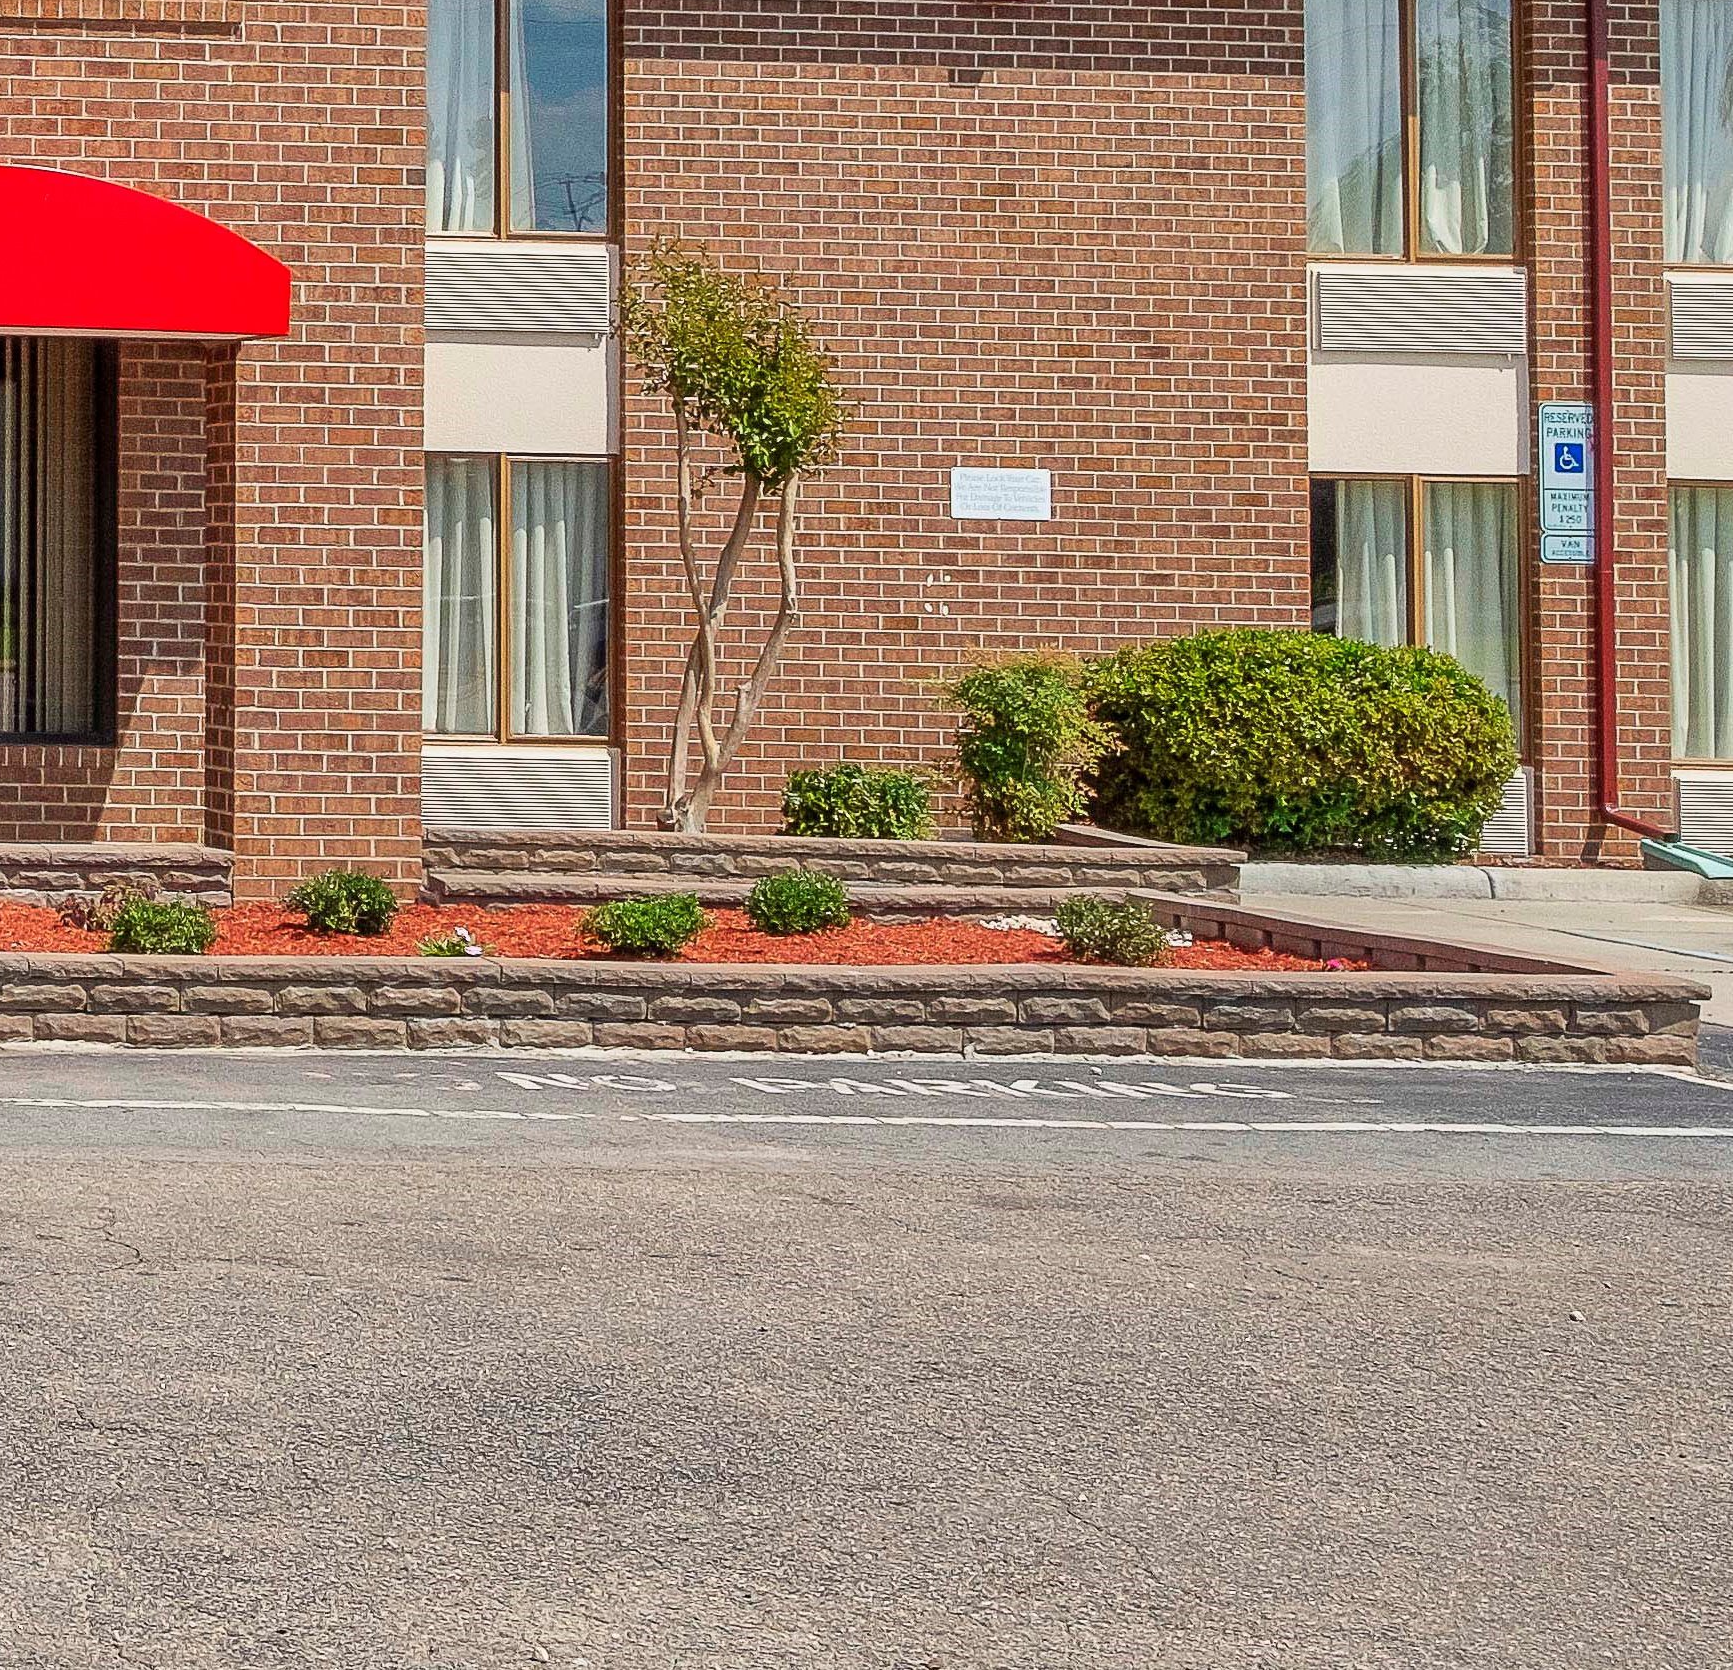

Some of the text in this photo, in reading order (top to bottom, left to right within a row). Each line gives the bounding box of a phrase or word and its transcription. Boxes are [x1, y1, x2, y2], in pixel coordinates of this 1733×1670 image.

[1544, 411, 1593, 424] RESERVED
[1546, 427, 1592, 439] PARKING
[1550, 492, 1590, 501] MAXIMUM
[1551, 503, 1588, 513] PENALTY
[1560, 540, 1580, 549] VAN
[495, 1070, 1299, 1099] NO PARKING
